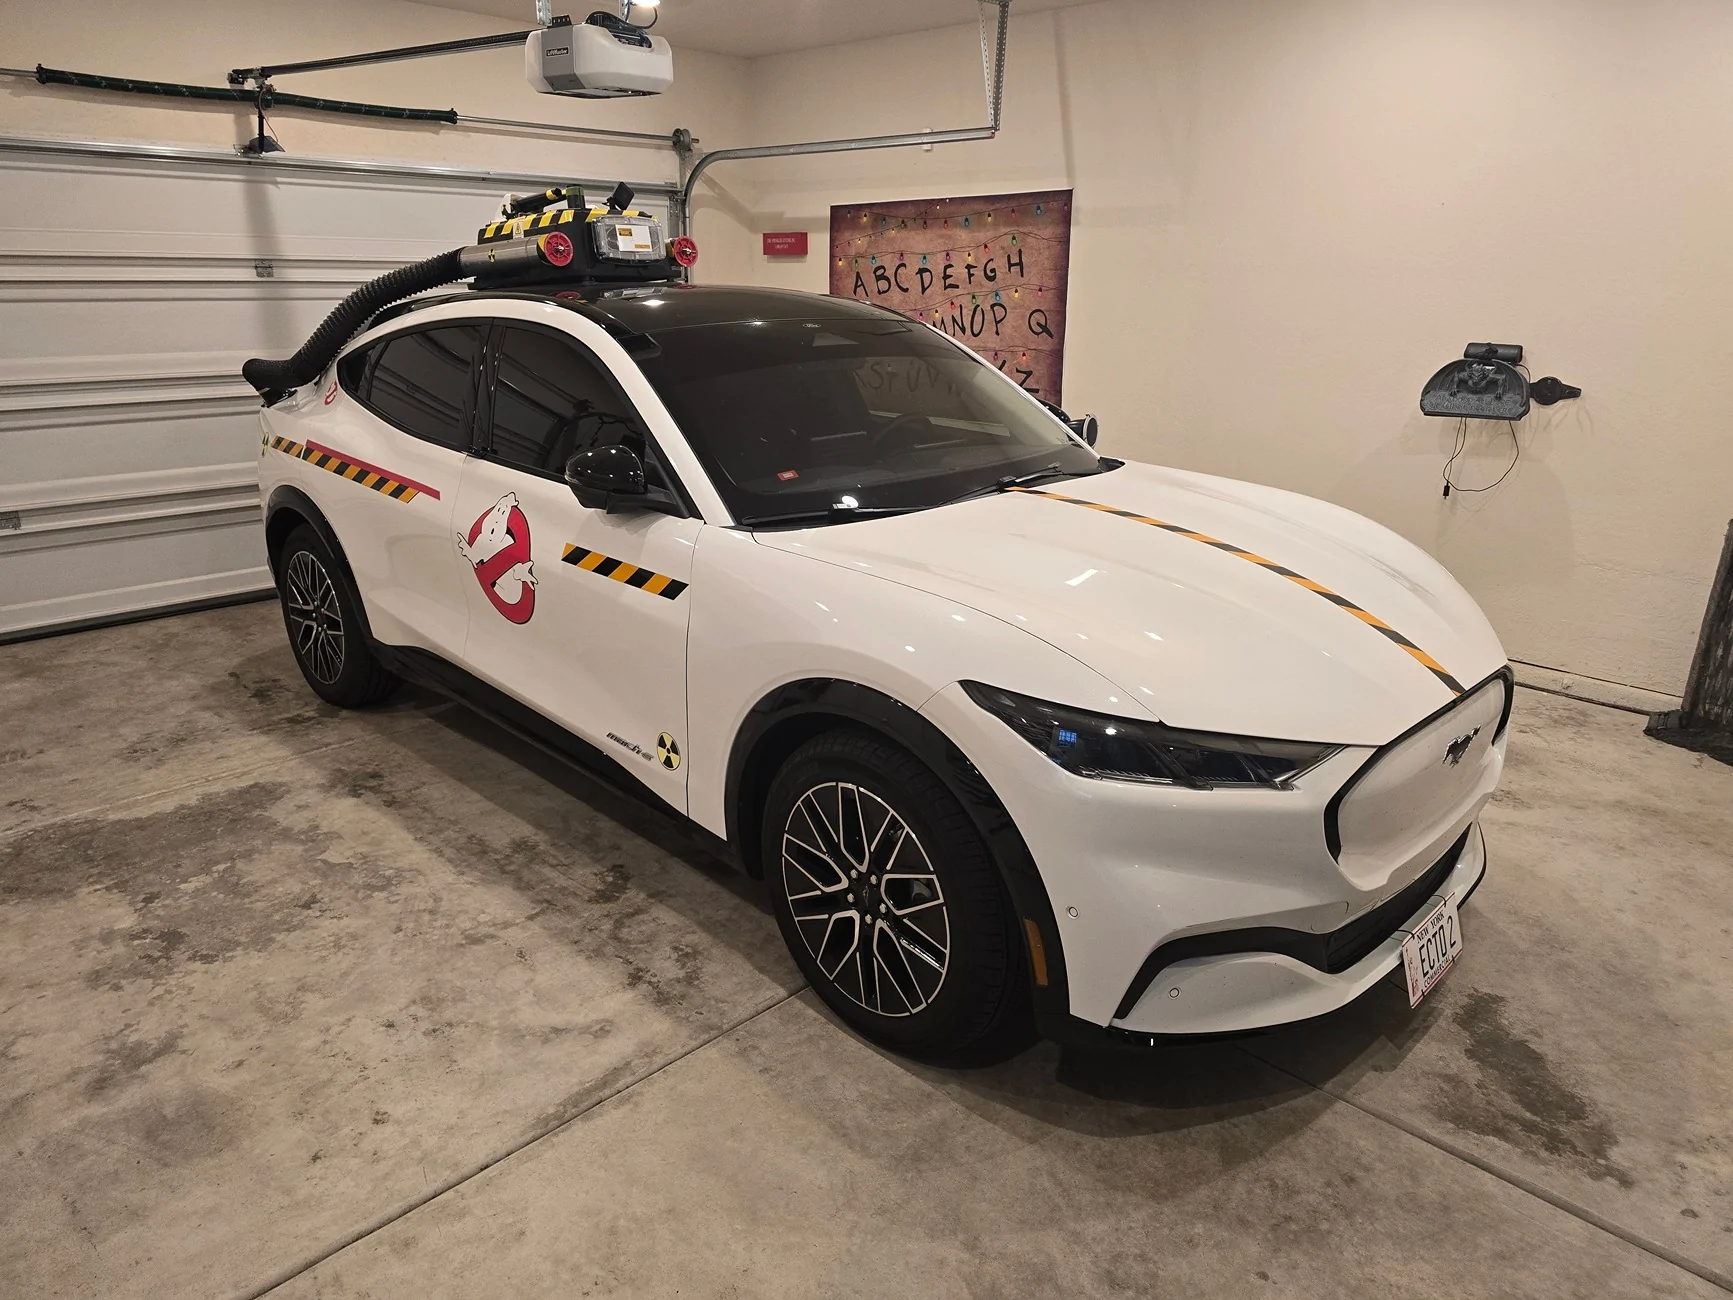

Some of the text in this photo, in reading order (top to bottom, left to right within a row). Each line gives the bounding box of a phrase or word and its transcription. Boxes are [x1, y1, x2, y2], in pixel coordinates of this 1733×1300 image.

[1416, 909, 1445, 944] NEW YORK
[1419, 915, 1457, 978] ECTO 2
[1424, 954, 1450, 987] COMMERCIAL
